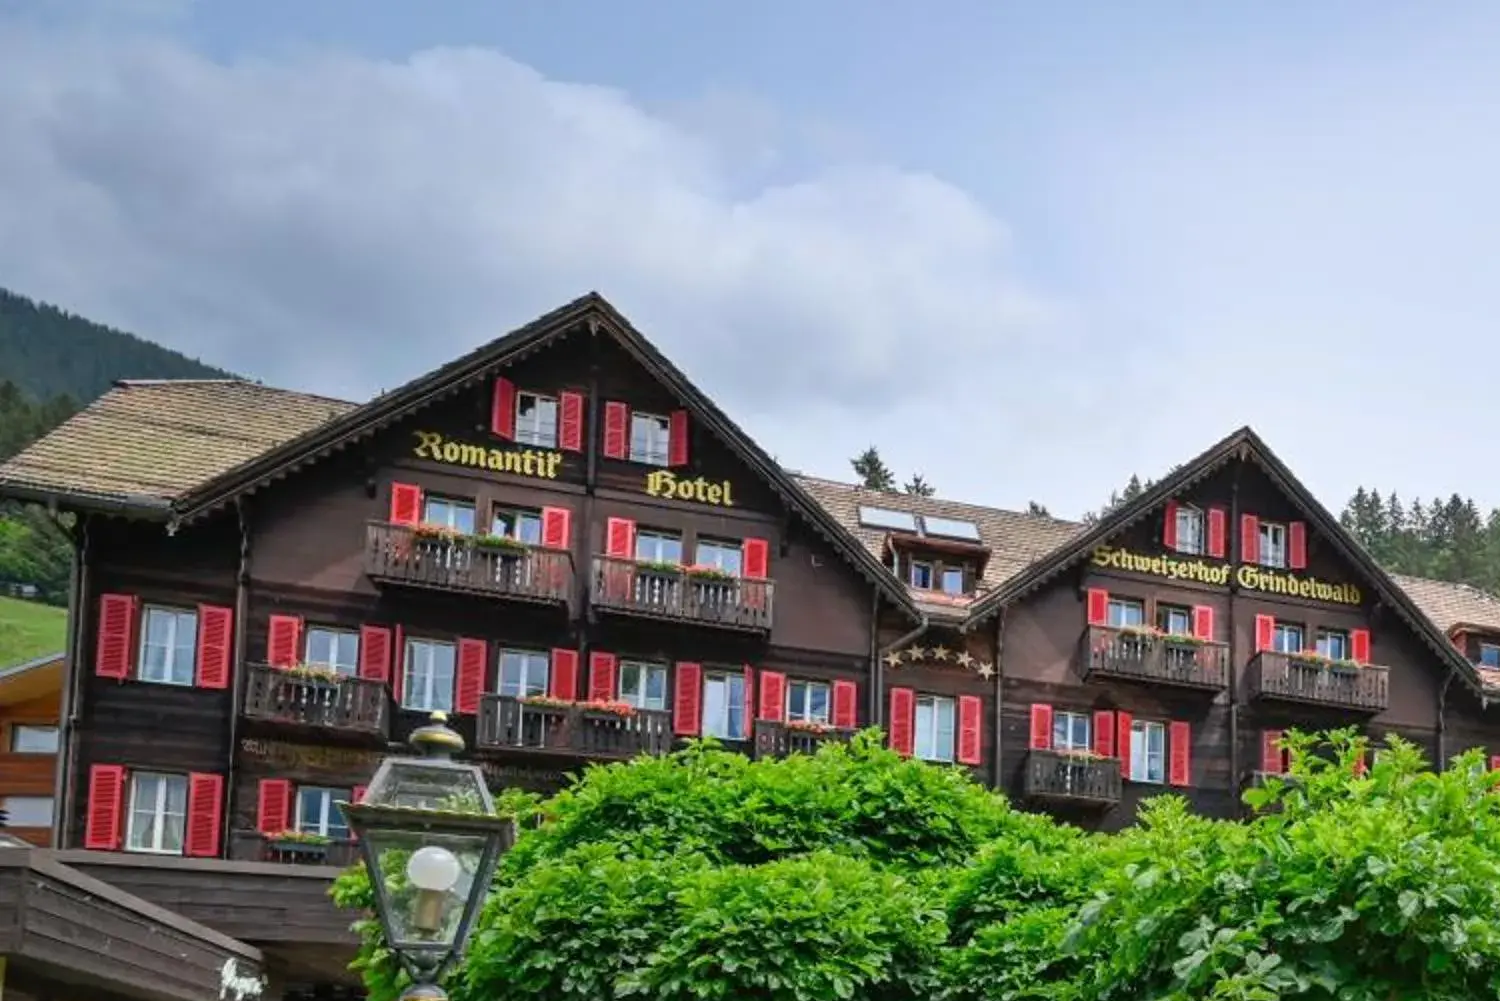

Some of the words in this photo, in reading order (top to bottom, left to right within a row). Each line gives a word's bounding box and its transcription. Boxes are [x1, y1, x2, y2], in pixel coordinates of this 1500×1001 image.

[413, 430, 563, 479] Romantik
[646, 470, 733, 507] Hotel
[1092, 545, 1231, 584] Schweizerhof
[1237, 565, 1361, 604] Grindelwald
